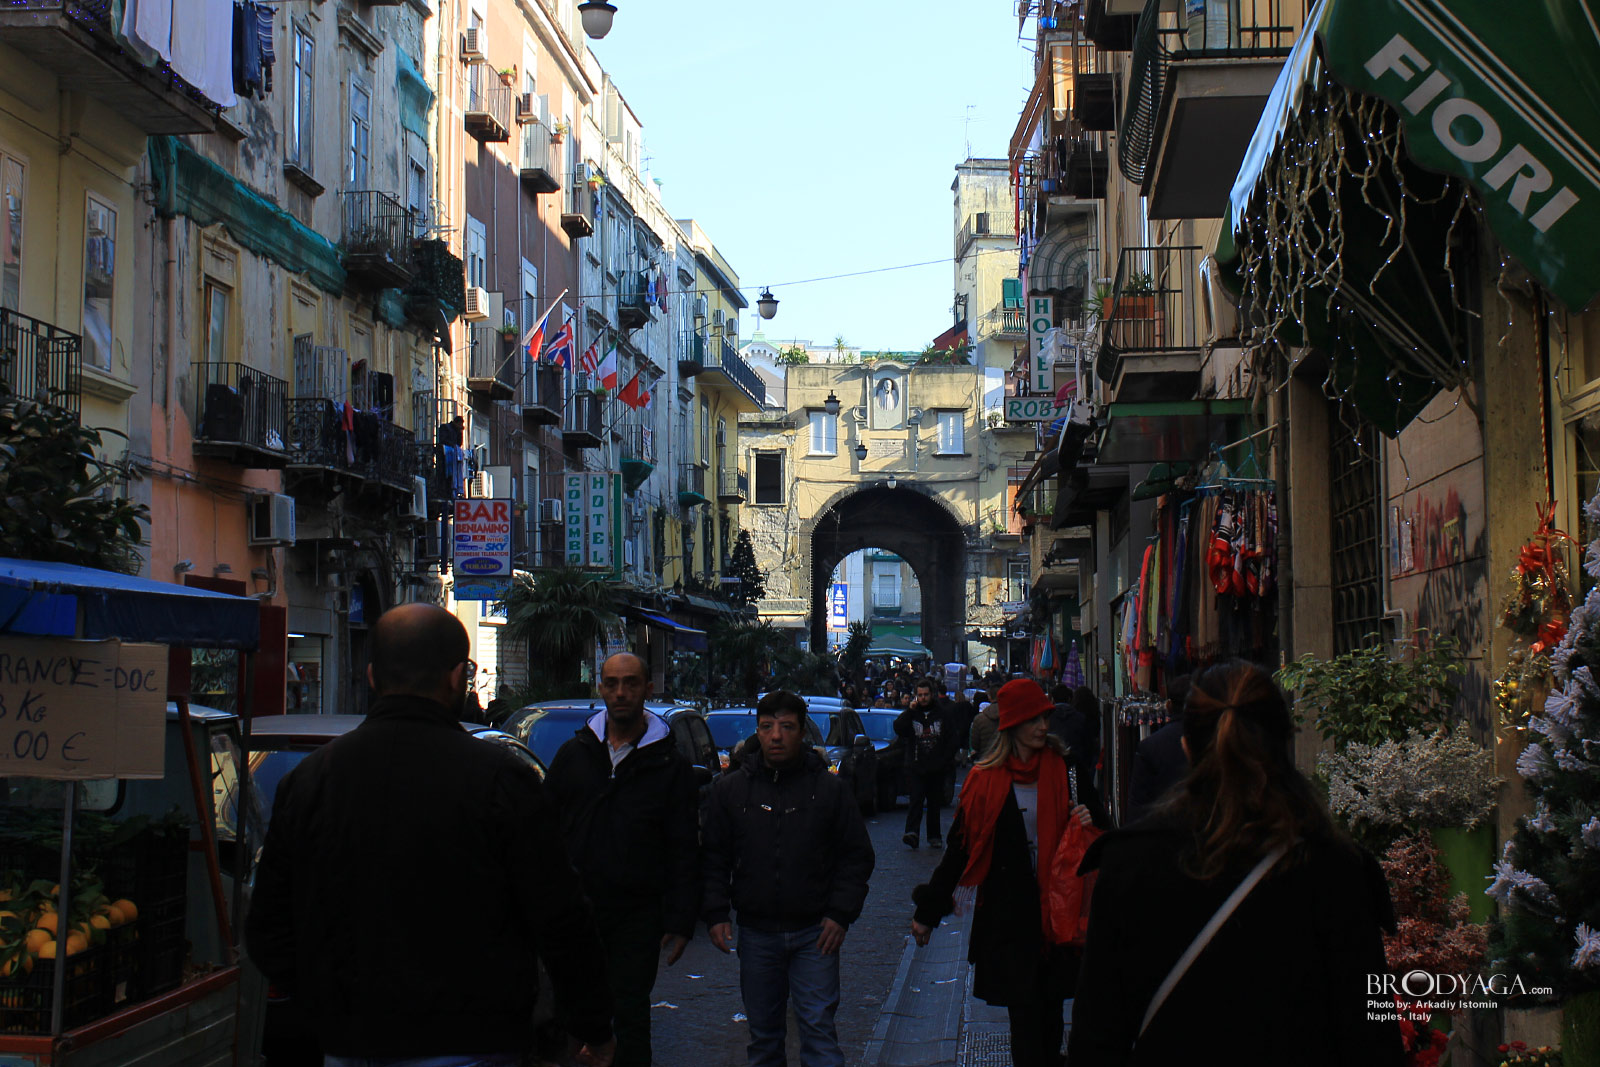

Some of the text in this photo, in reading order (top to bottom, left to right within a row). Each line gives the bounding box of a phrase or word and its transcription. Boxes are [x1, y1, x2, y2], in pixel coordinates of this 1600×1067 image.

[1364, 33, 1580, 233] FIORI
[455, 499, 510, 522] BAR
[568, 476, 581, 563] COLOMBO
[592, 476, 605, 563] HOTEL
[455, 523, 510, 534] BENIAMINO
[485, 543, 508, 551] SKY
[62, 731, 89, 762] €
